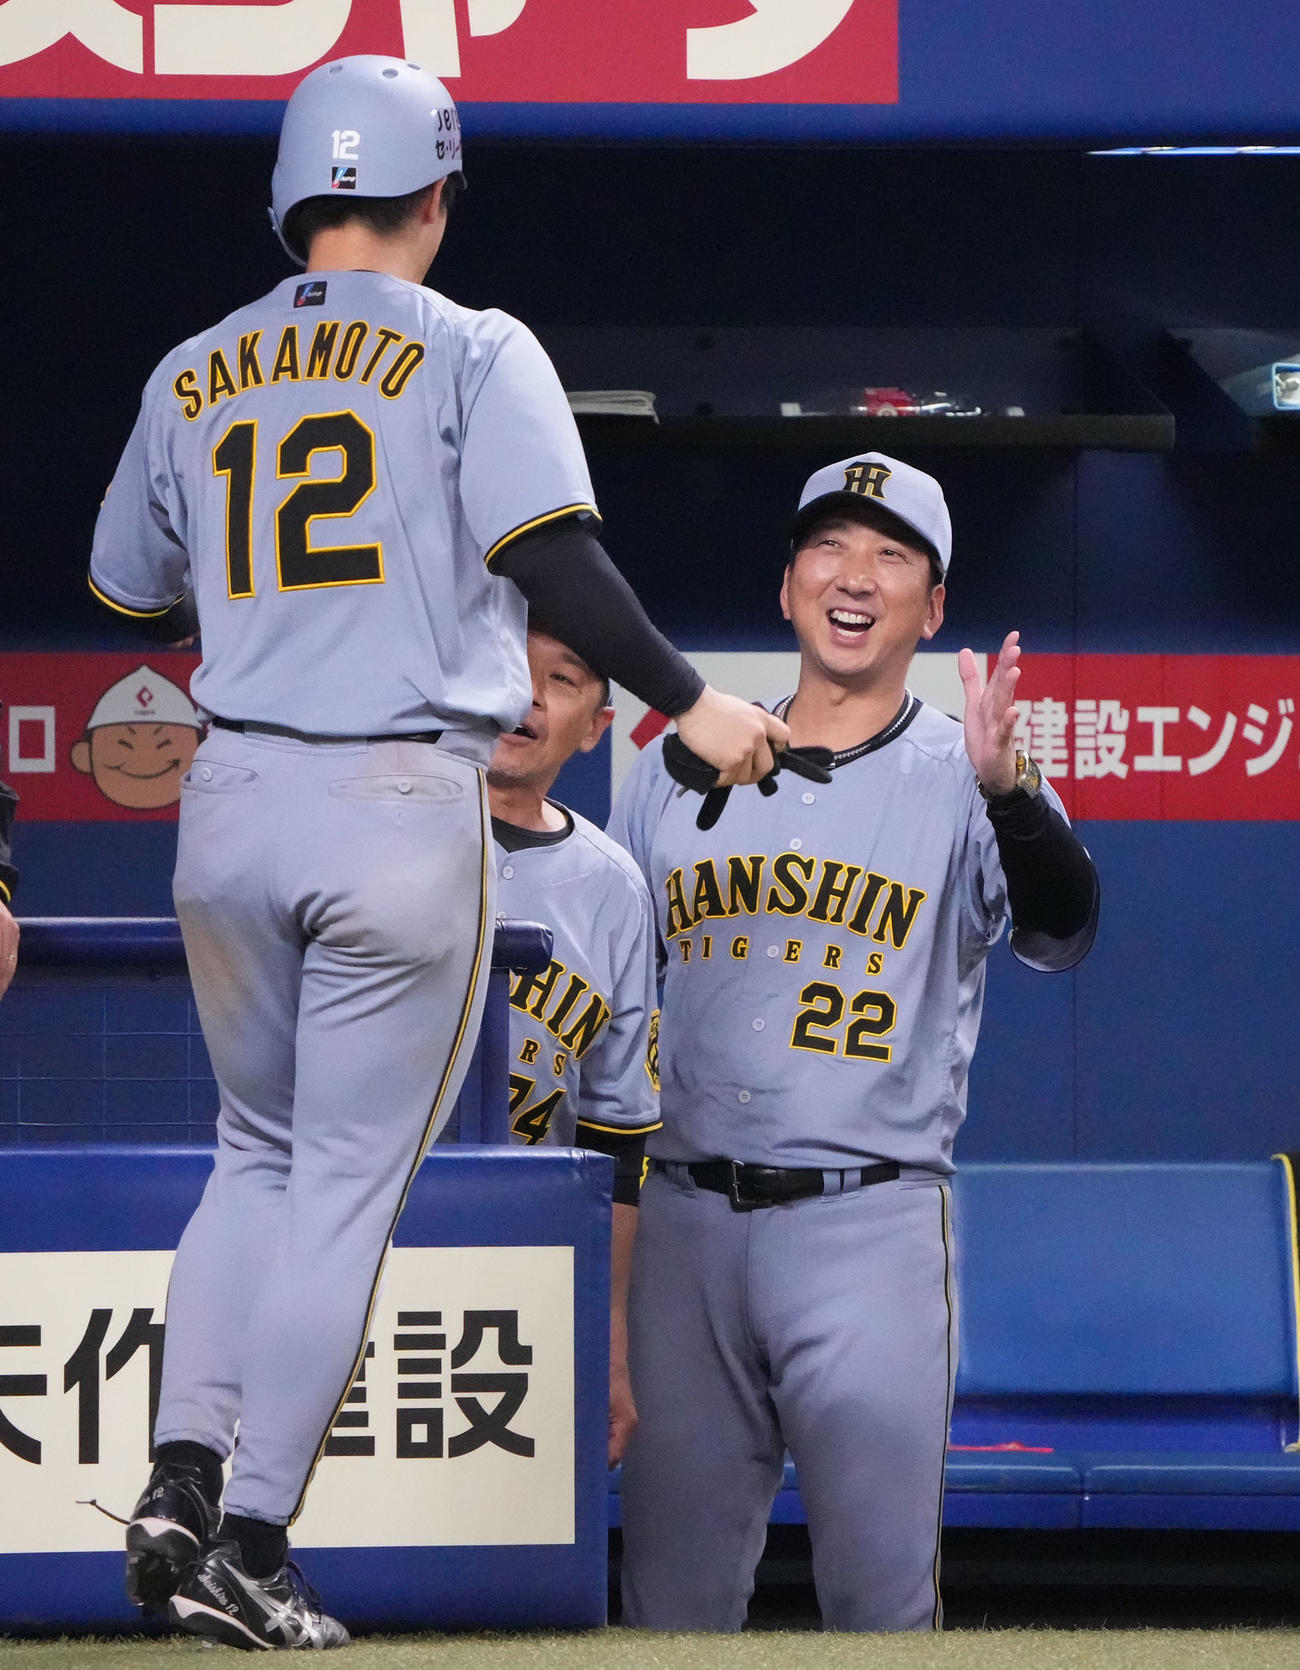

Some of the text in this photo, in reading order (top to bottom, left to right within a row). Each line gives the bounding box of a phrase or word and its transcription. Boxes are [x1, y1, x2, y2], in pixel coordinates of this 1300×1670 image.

[331, 129, 361, 160] 12
[173, 320, 425, 421] SAKAMOTO
[212, 409, 386, 600] 12
[1012, 697, 1300, 779] 建設エンジ
[666, 852, 927, 950] HANSHIN
[679, 935, 884, 976] TIGERS
[789, 980, 897, 1063] 22
